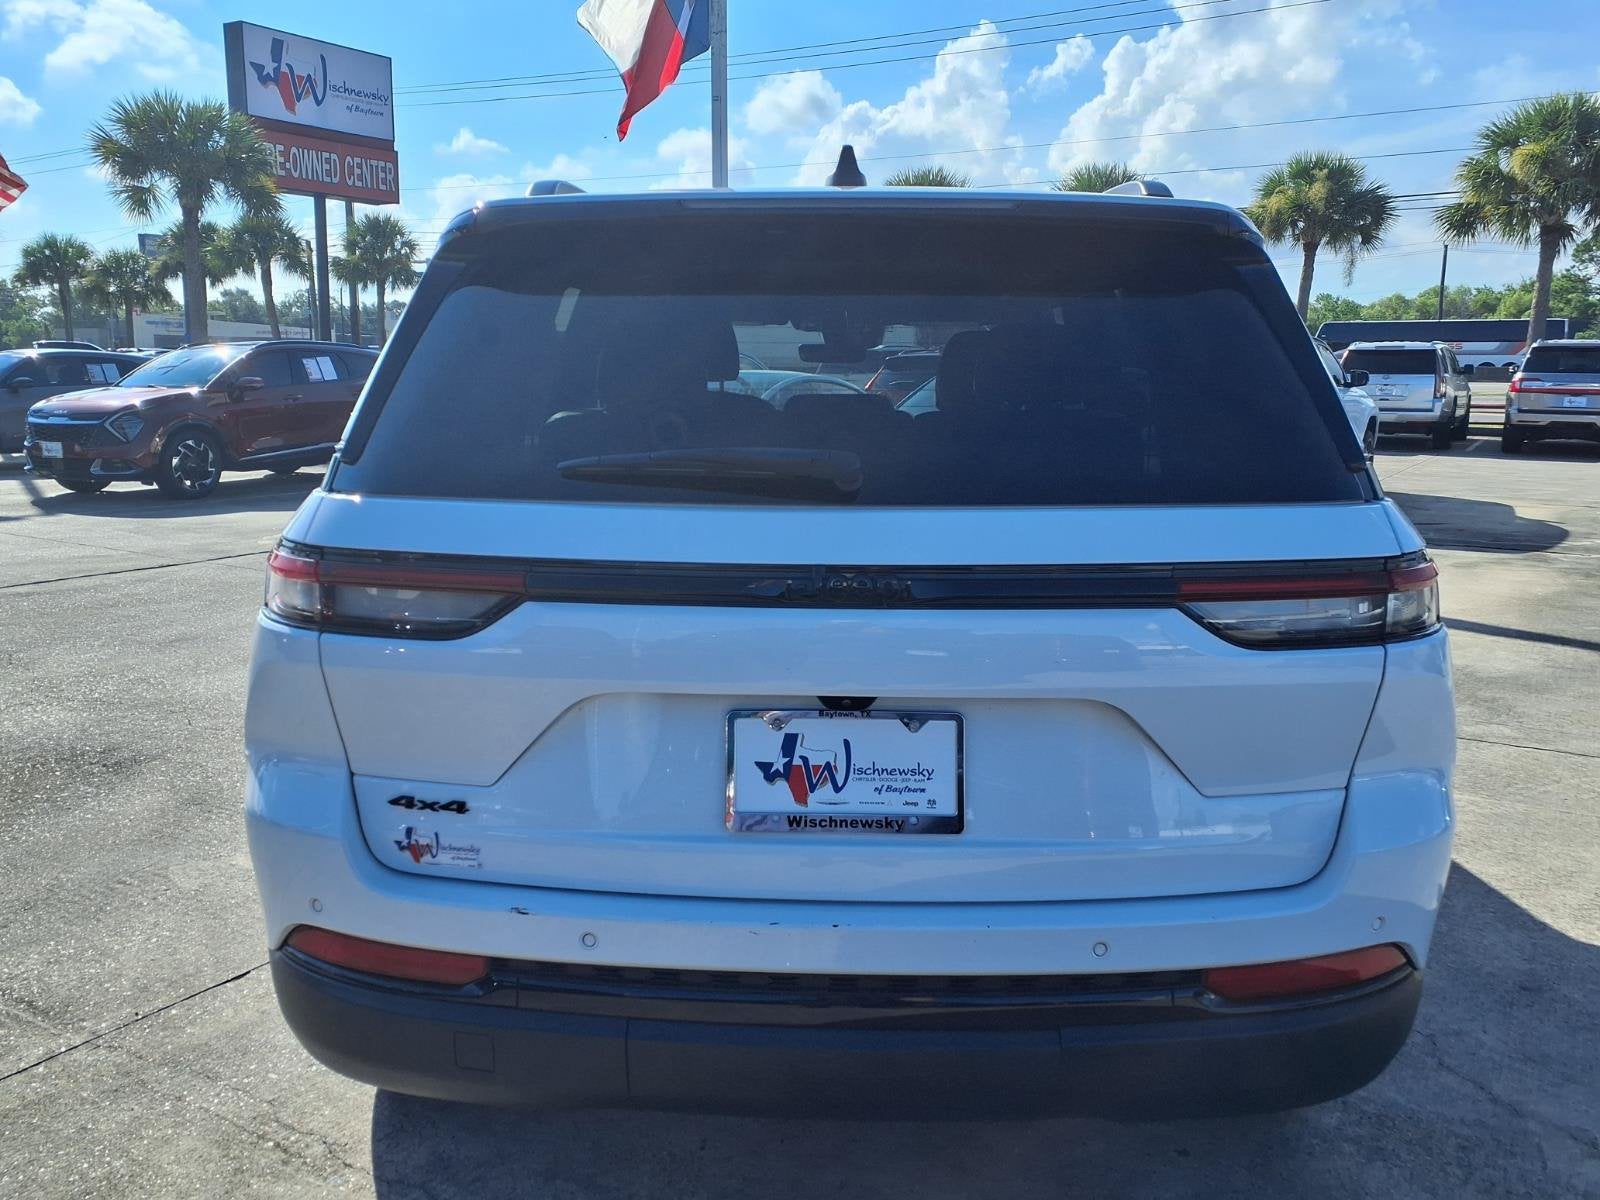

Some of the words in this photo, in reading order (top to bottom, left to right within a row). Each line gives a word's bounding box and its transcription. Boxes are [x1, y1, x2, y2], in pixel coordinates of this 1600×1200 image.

[285, 53, 389, 107] Wischnewsky
[345, 155, 396, 192] CENTER
[798, 738, 935, 794] Wischnewsky
[873, 784, 885, 795] of
[885, 784, 927, 795] Baytown
[387, 795, 470, 814] 4x4
[902, 799, 919, 807] Jeep
[787, 814, 905, 833] Wischnewsky
